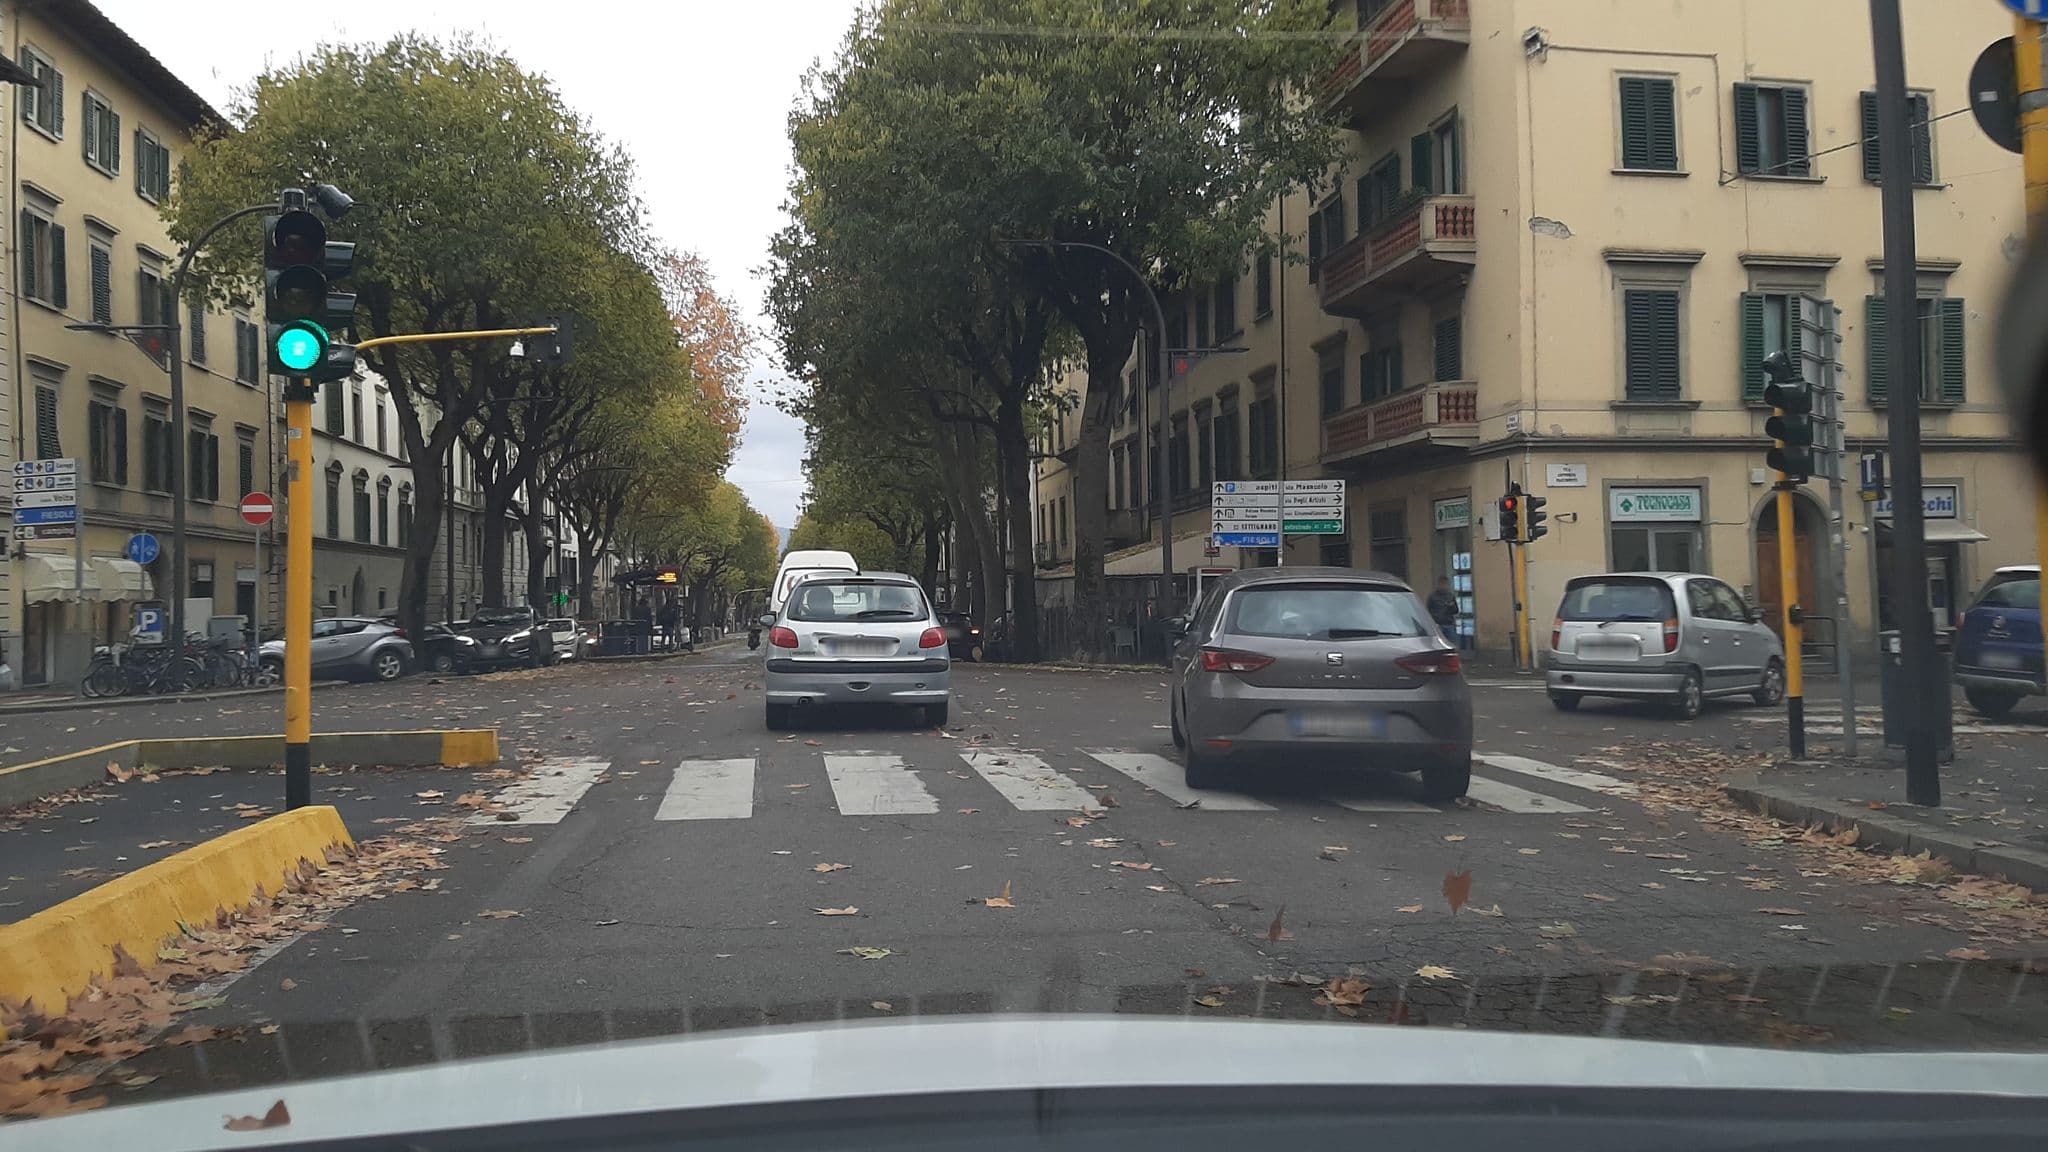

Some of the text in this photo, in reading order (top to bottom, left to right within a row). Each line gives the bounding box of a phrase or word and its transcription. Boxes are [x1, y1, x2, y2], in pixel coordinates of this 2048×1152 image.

[1862, 454, 1876, 482] T
[1637, 495, 1691, 510] TECNOCASA
[41, 511, 75, 519] FIESOLE
[1242, 536, 1277, 544] FIESOLE
